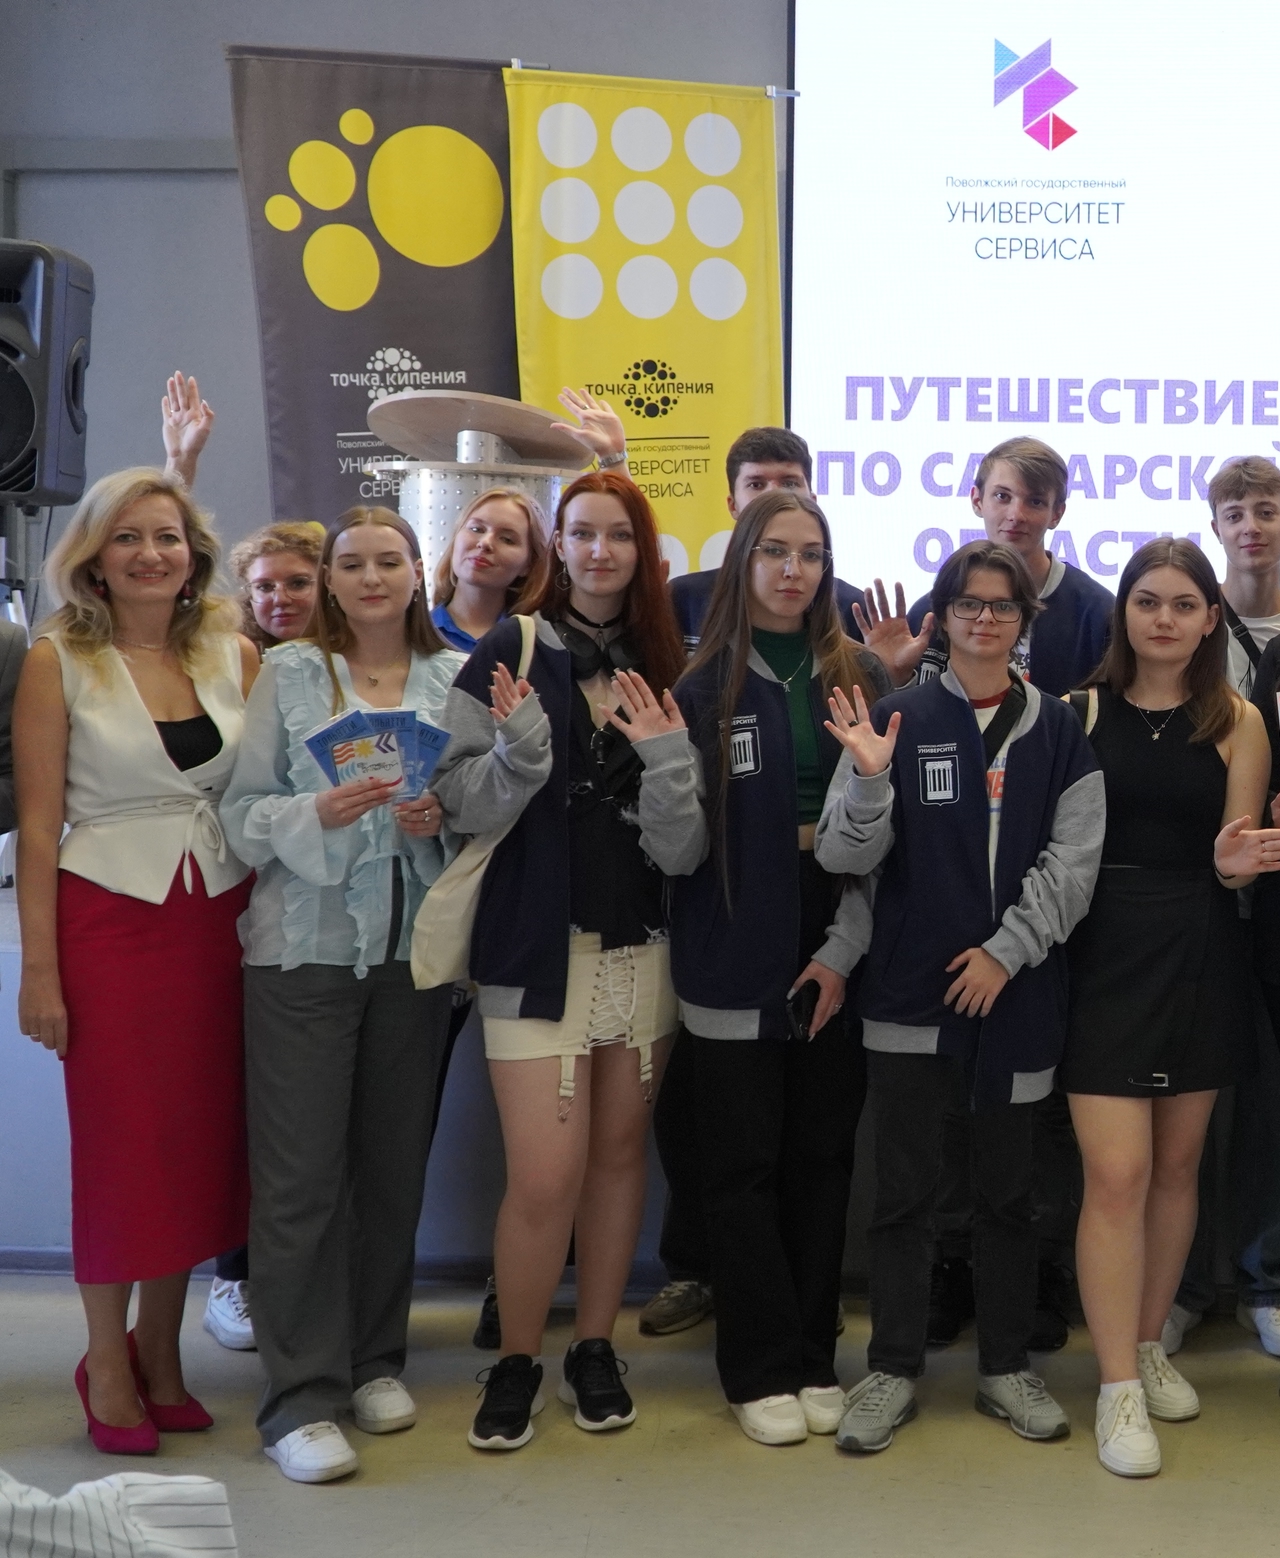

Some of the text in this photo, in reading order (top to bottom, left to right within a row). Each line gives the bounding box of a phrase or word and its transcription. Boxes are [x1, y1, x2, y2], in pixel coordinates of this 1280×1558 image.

[946, 176, 1126, 190] Поволжский государственный
[946, 201, 1125, 224] УНИВЕРСИТЕТ
[975, 237, 1095, 260] СЕРВИСА
[844, 375, 1280, 426] ПУТЕШЕСТВИЕ
[336, 439, 385, 449] Поволжский
[643, 444, 711, 453] государственный
[628, 458, 711, 476] ВЕРСИТЕТ
[816, 450, 902, 497] ПО
[359, 479, 401, 498] СЕРВ
[637, 482, 694, 499] РВИСА
[917, 745, 957, 754] УНИВЕРСИТЕТ
